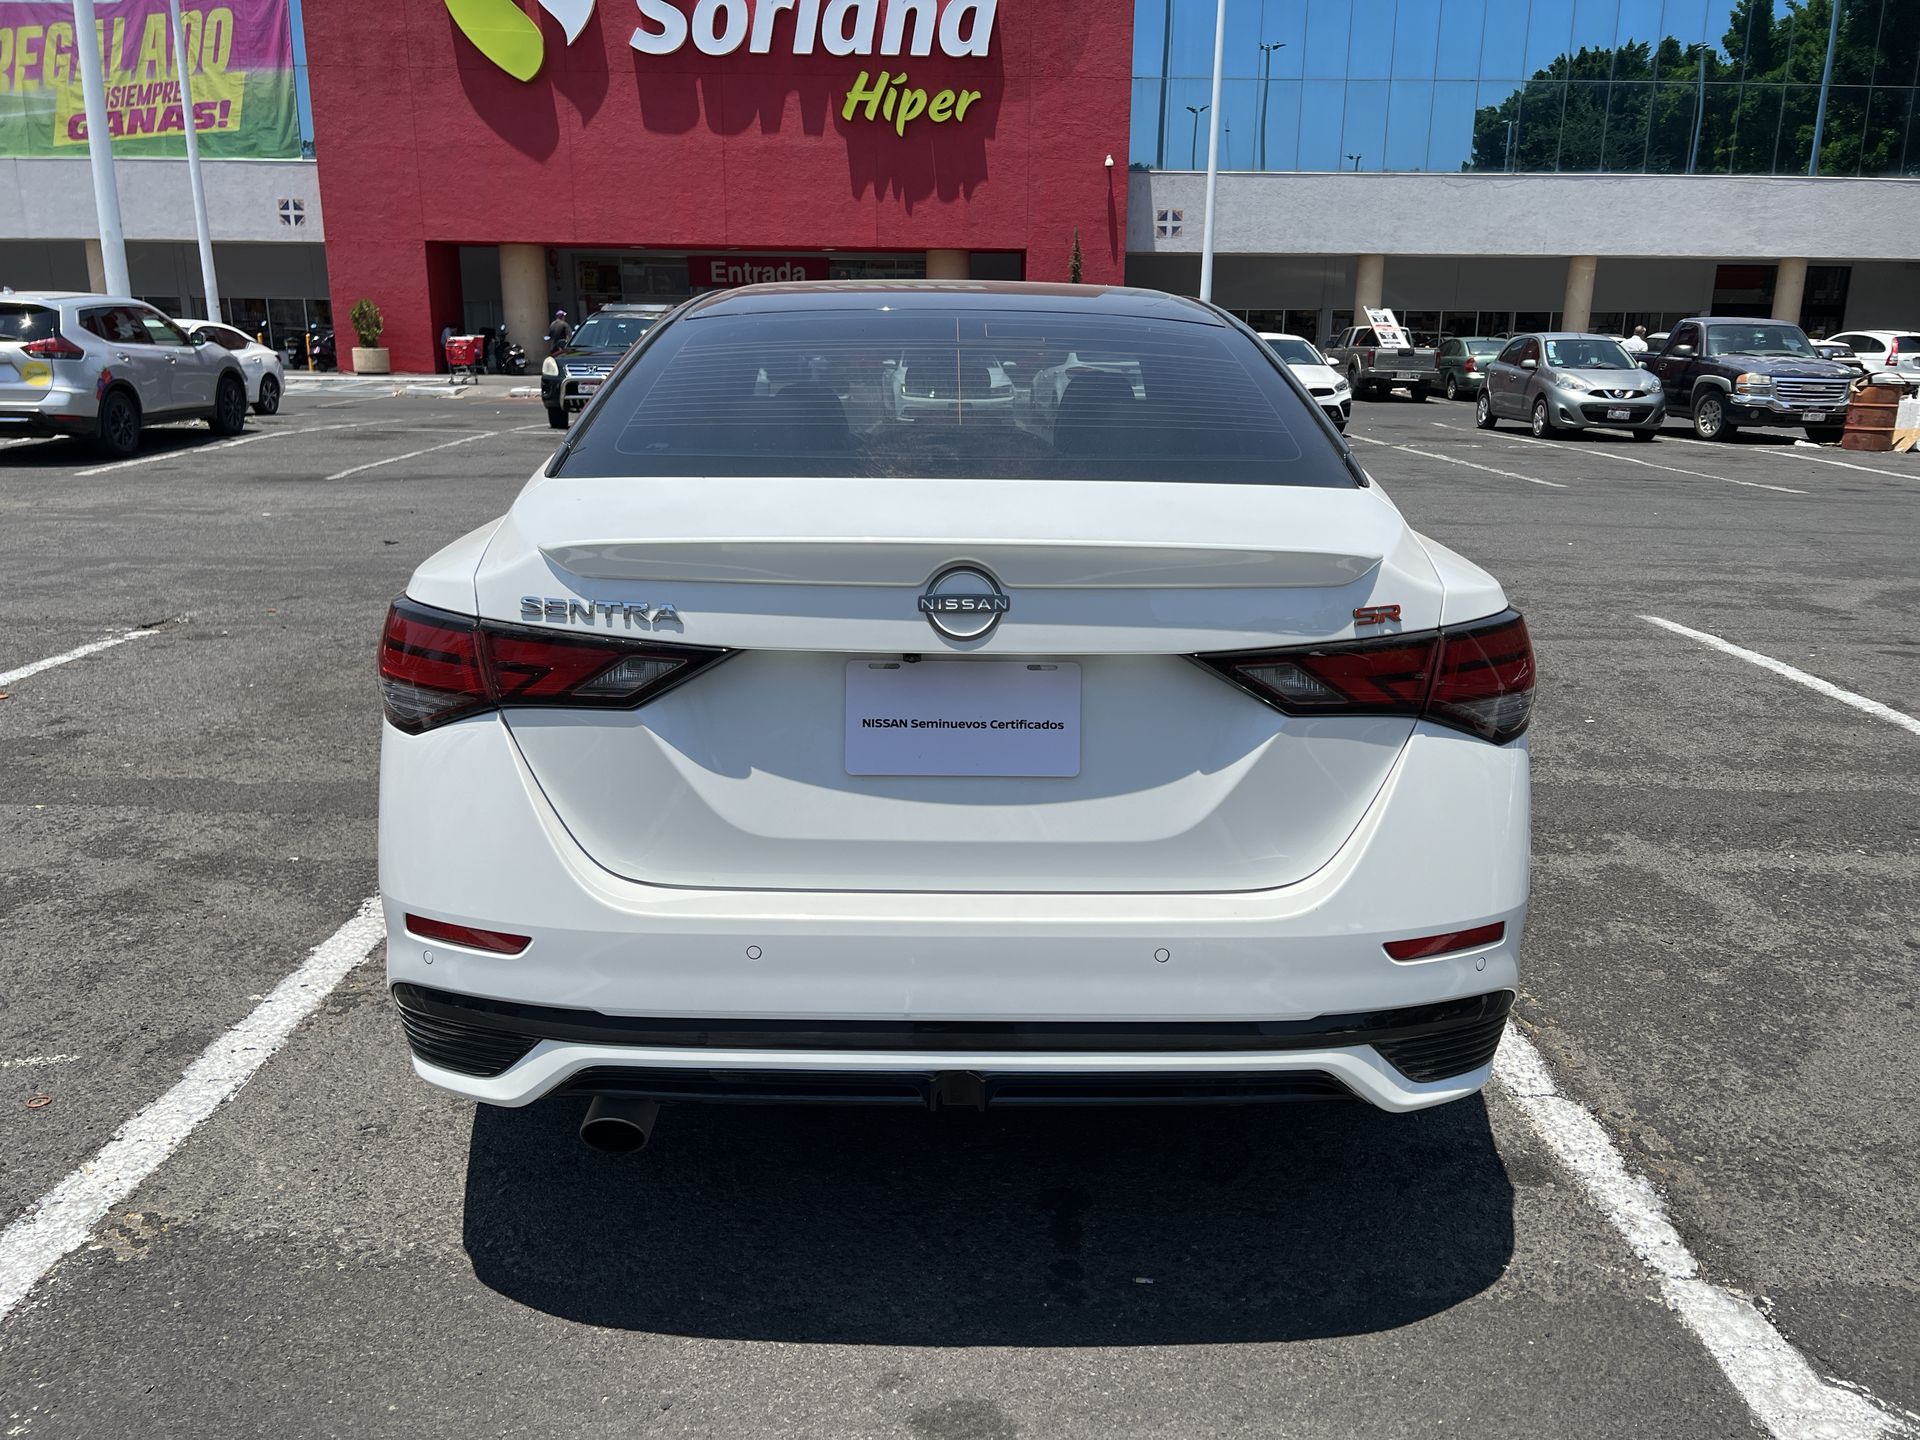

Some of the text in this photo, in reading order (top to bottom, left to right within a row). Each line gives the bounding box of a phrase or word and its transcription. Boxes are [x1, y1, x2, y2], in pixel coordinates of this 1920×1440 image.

[629, 0, 997, 57] Soriana
[841, 71, 981, 137] Híper
[67, 99, 232, 141] GANAS!
[711, 261, 806, 283] Entrada
[520, 596, 684, 628] SENTRA
[921, 598, 1007, 610] NISSAN
[1352, 604, 1402, 626] SR
[862, 718, 1065, 730] NISSAN Seminuevos Certificados
